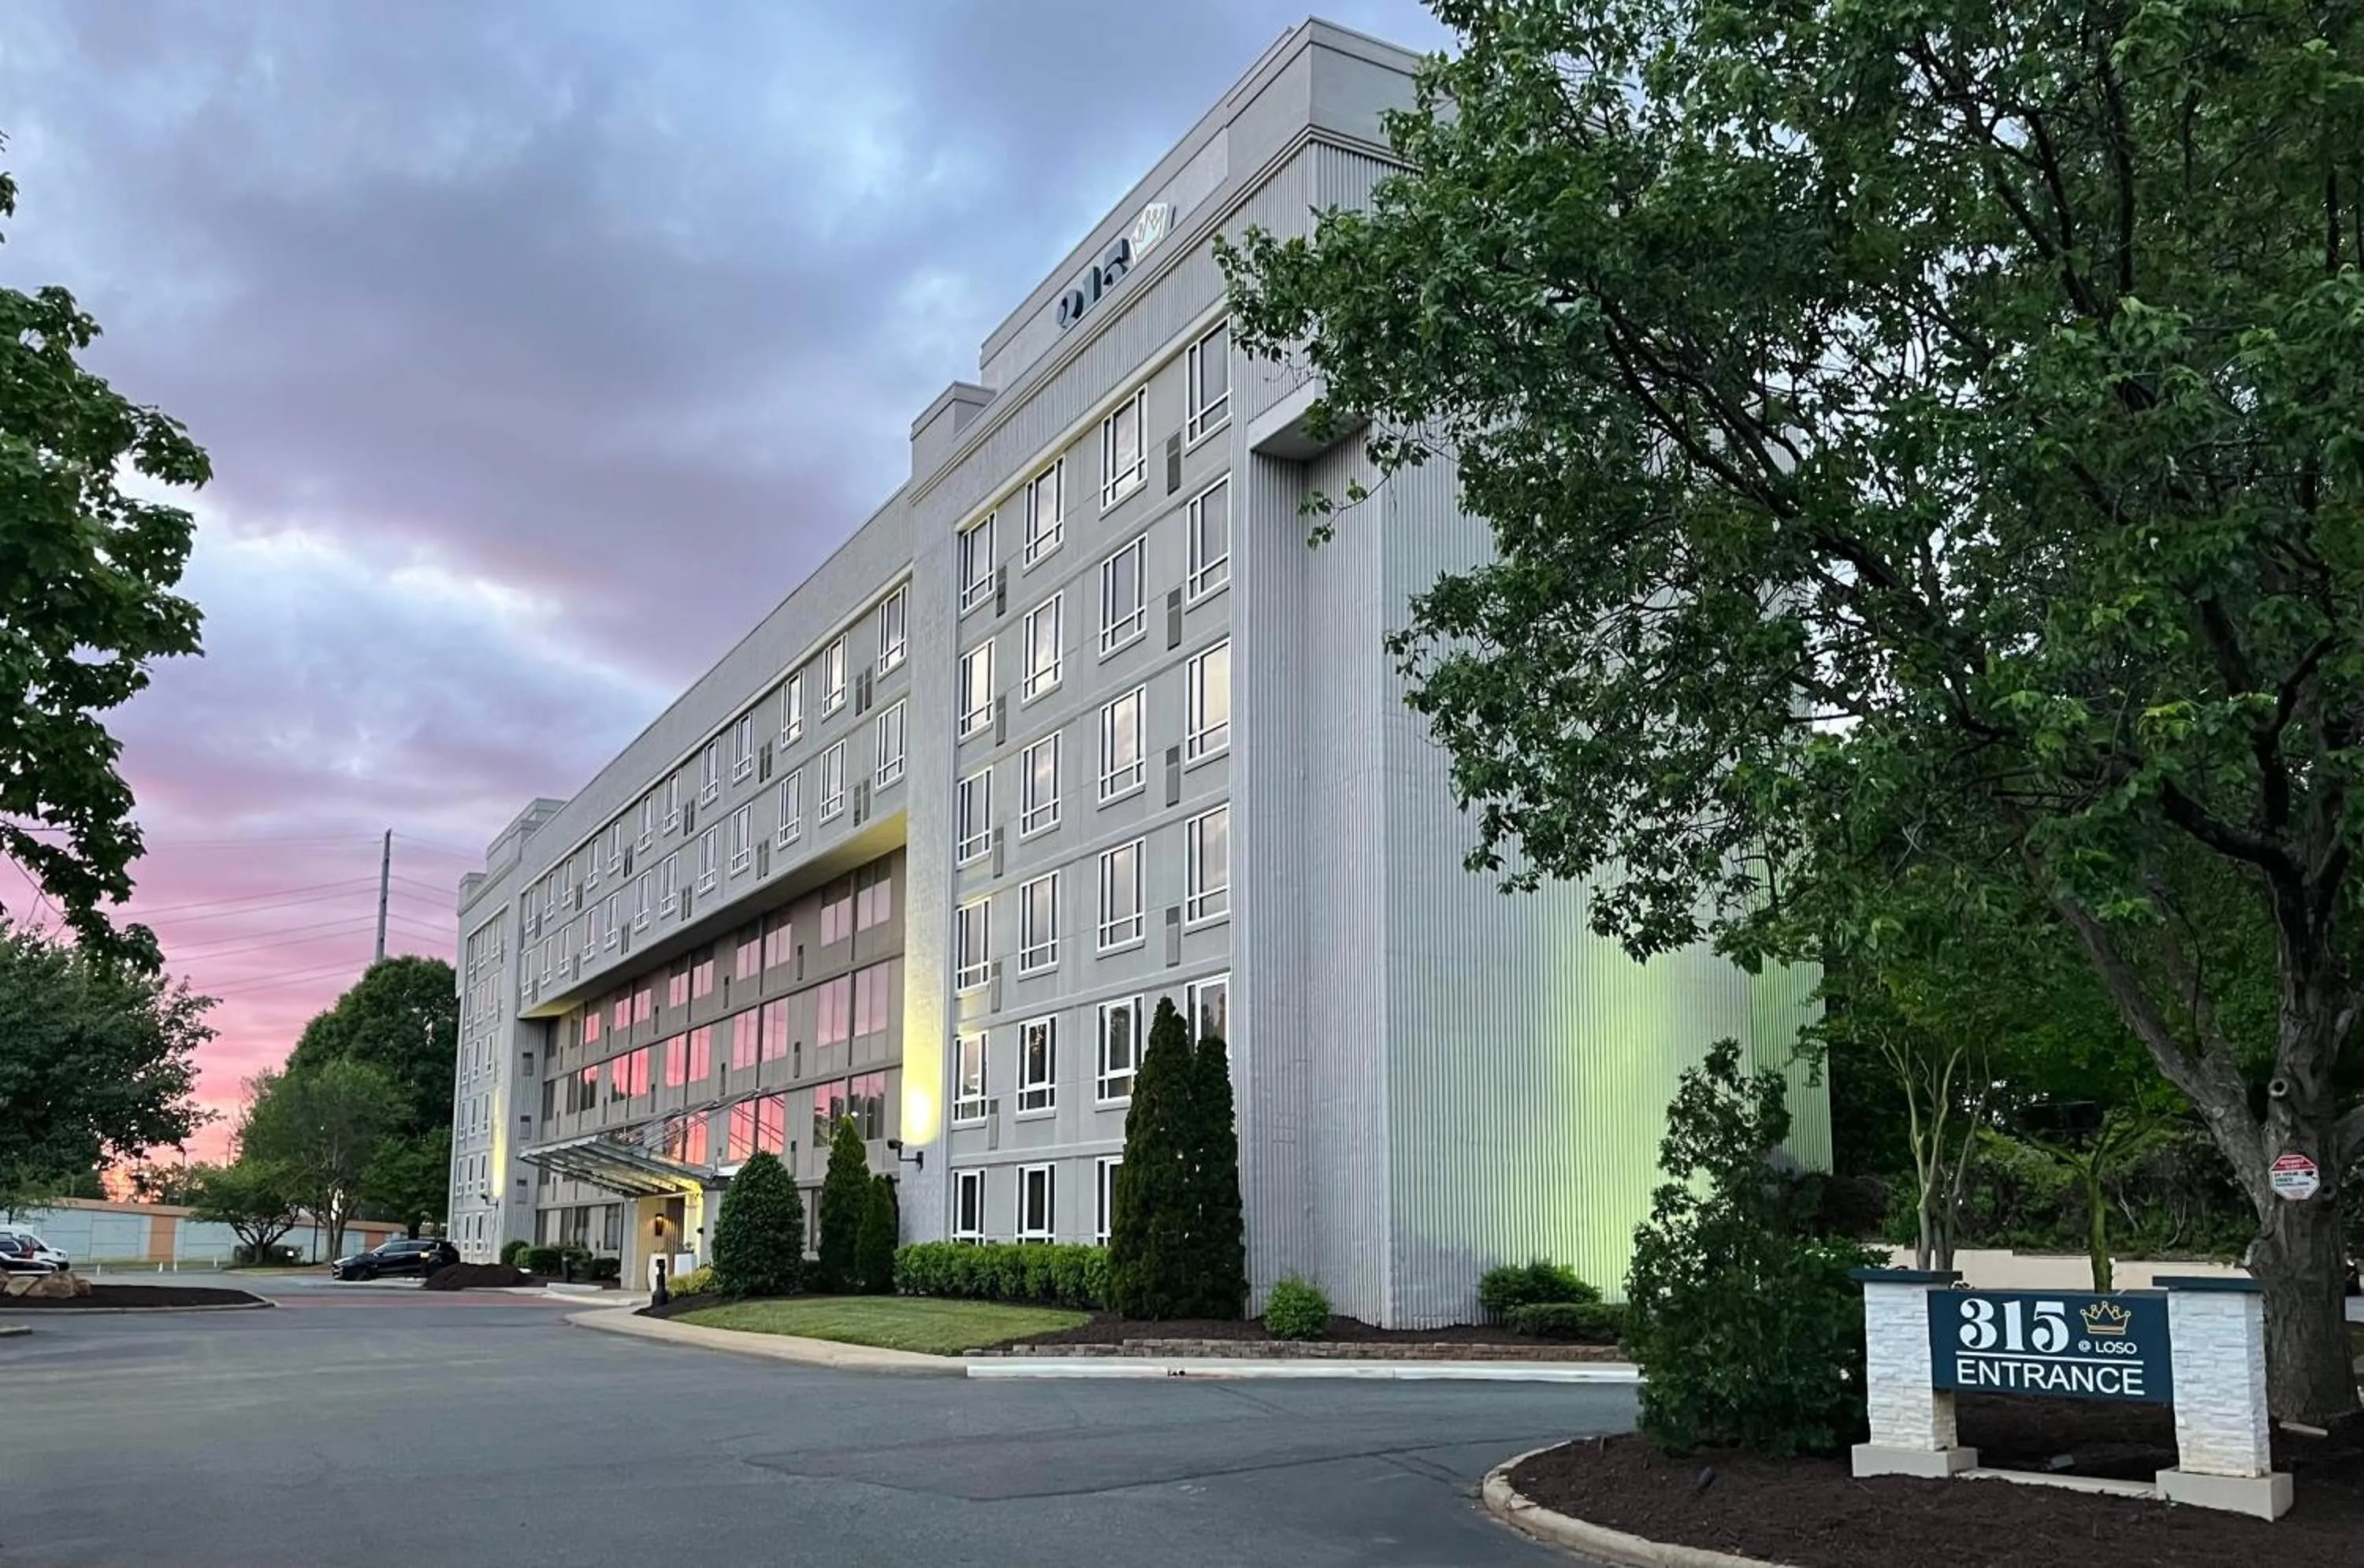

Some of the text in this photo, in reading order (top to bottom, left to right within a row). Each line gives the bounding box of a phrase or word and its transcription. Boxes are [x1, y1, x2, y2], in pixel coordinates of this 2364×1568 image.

[1959, 1298, 2070, 1354] 315
[2095, 1340, 2137, 1354] LOSO
[1956, 1358, 2145, 1395] ENTRANCE
